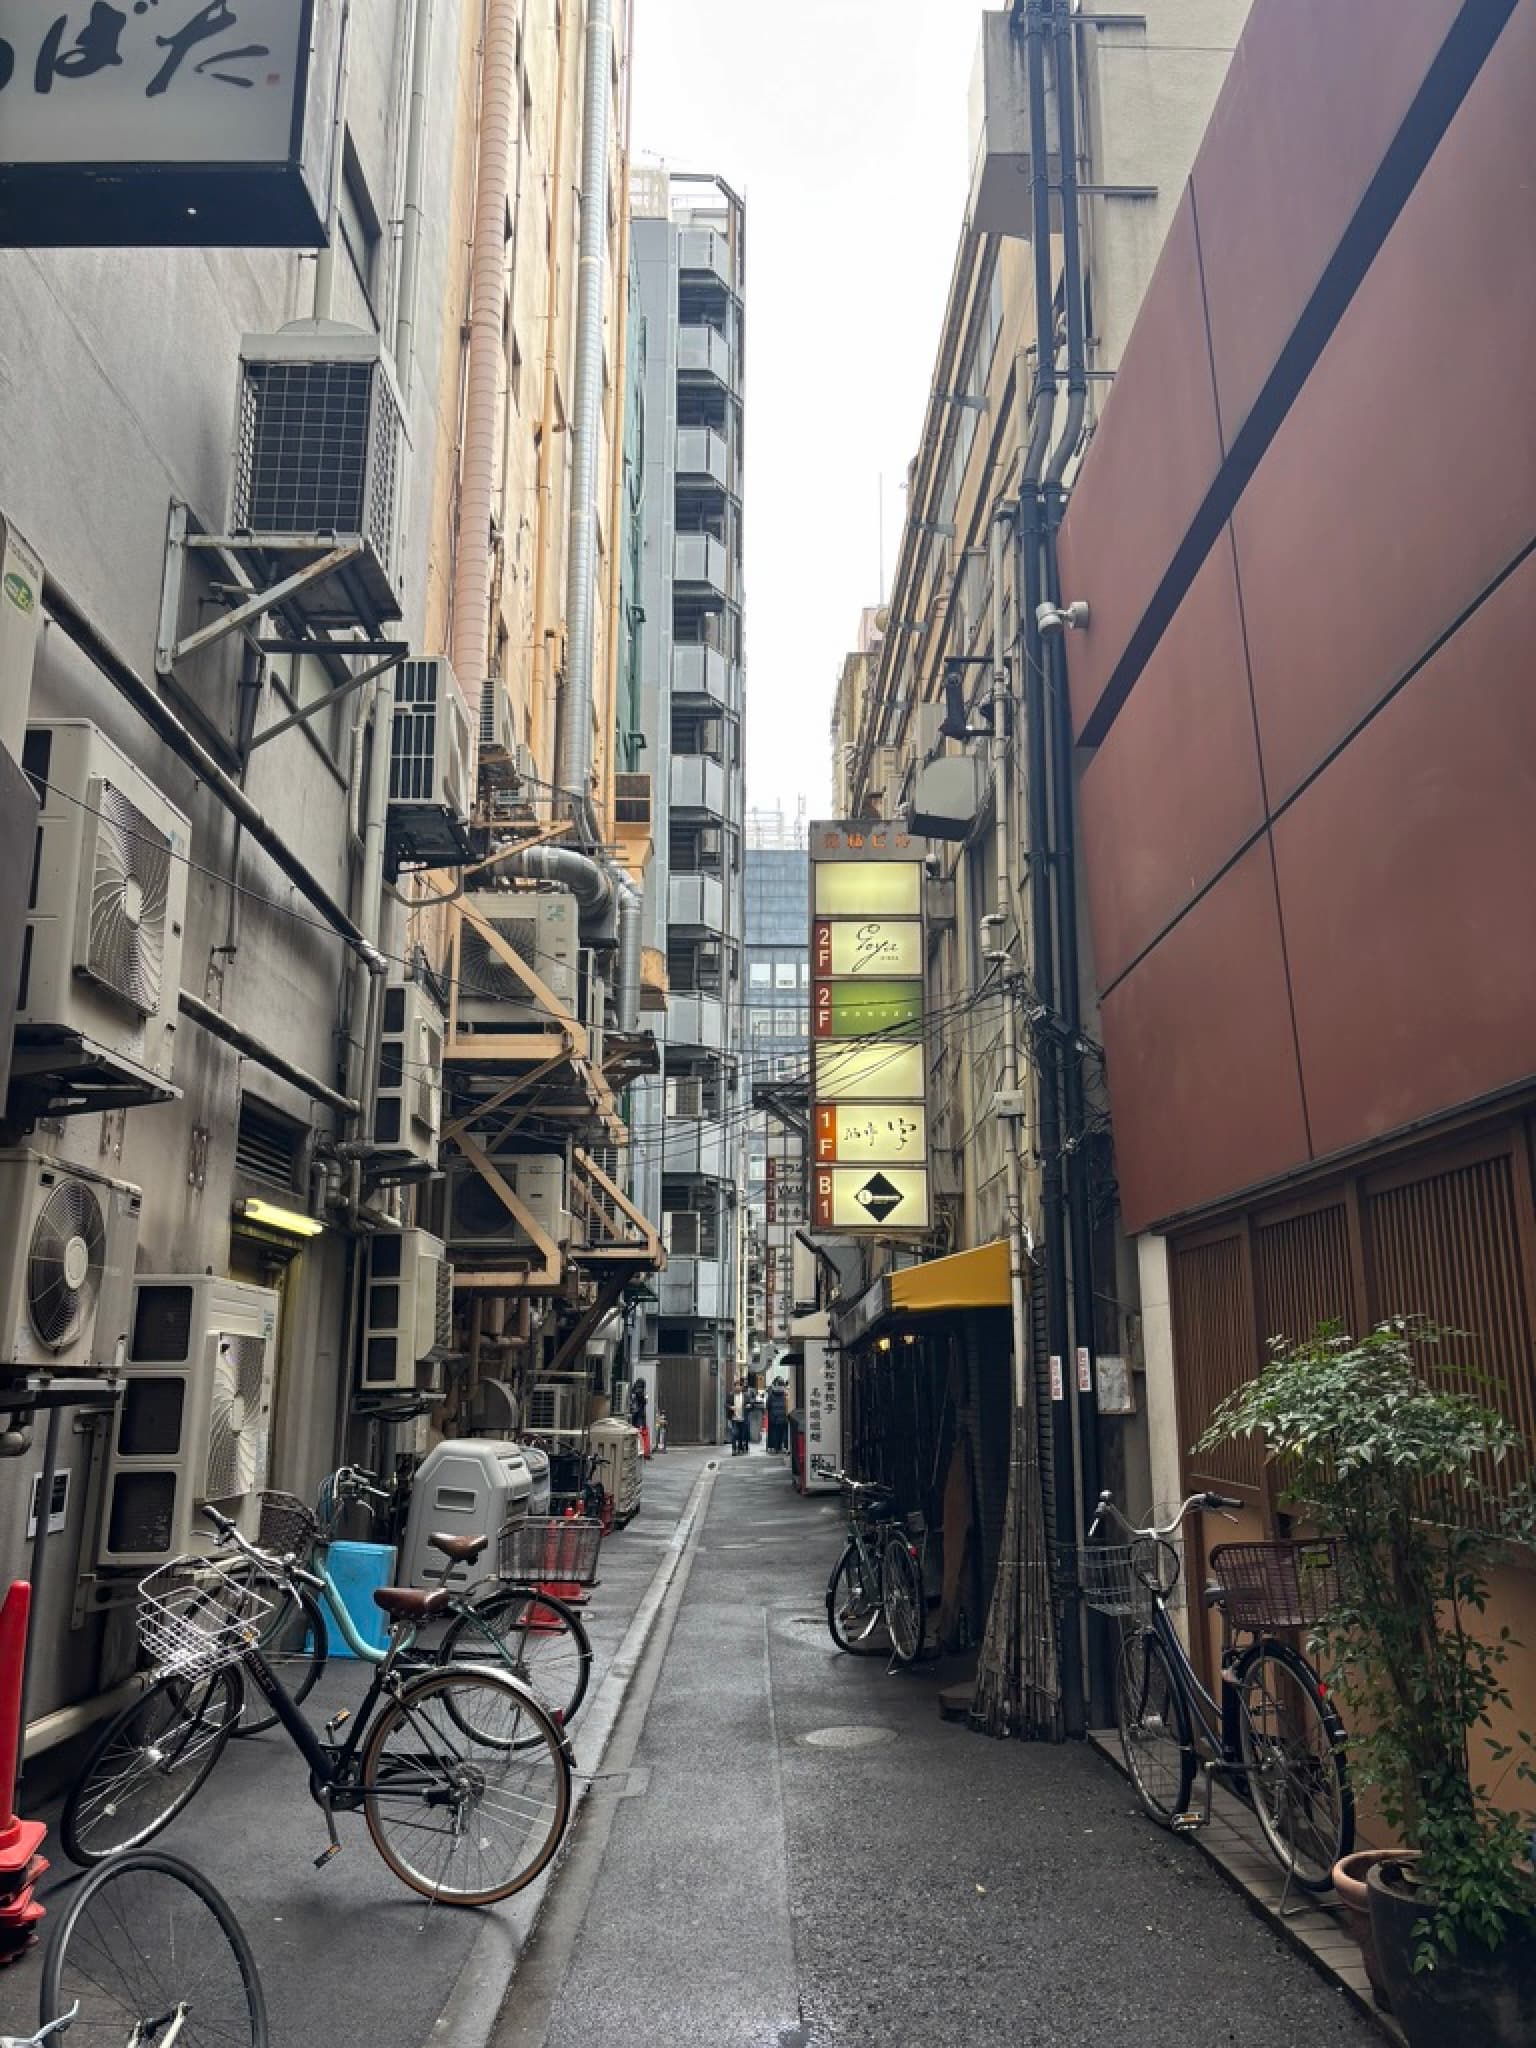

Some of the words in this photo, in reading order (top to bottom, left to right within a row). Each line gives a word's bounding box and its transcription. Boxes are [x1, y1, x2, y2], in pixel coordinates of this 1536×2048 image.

[0, 0, 269, 98] ばた
[818, 927, 830, 967] 2F
[818, 987, 830, 1029] 2F
[819, 1111, 833, 1155] 1F
[818, 1175, 831, 1219] B1
